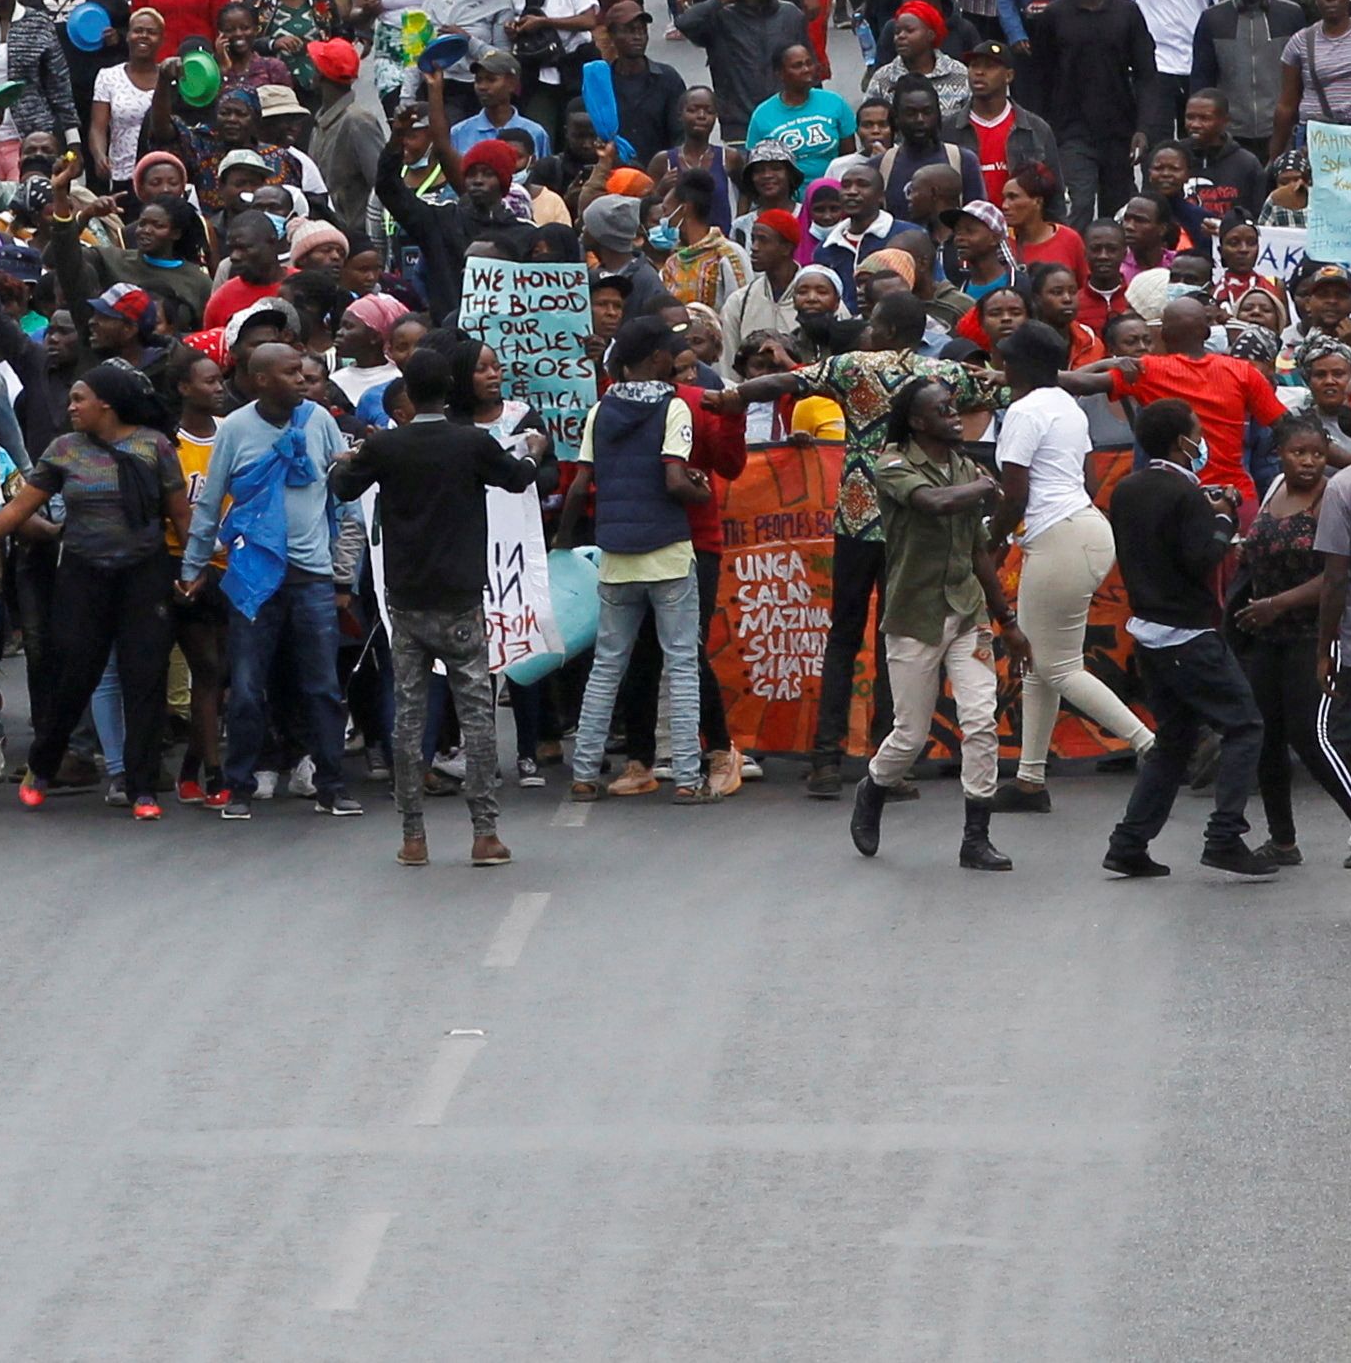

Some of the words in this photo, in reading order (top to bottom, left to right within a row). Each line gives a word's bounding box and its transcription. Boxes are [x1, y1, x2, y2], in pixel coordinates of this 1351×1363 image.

[472, 267, 505, 292] WE
[462, 293, 498, 314] THE
[510, 292, 588, 317] BLOOD
[499, 318, 539, 337] OUR
[735, 550, 806, 582] UNGA
[738, 580, 813, 613] SALAD
[738, 604, 834, 638] MAZIWA
[752, 678, 802, 702] GAS
